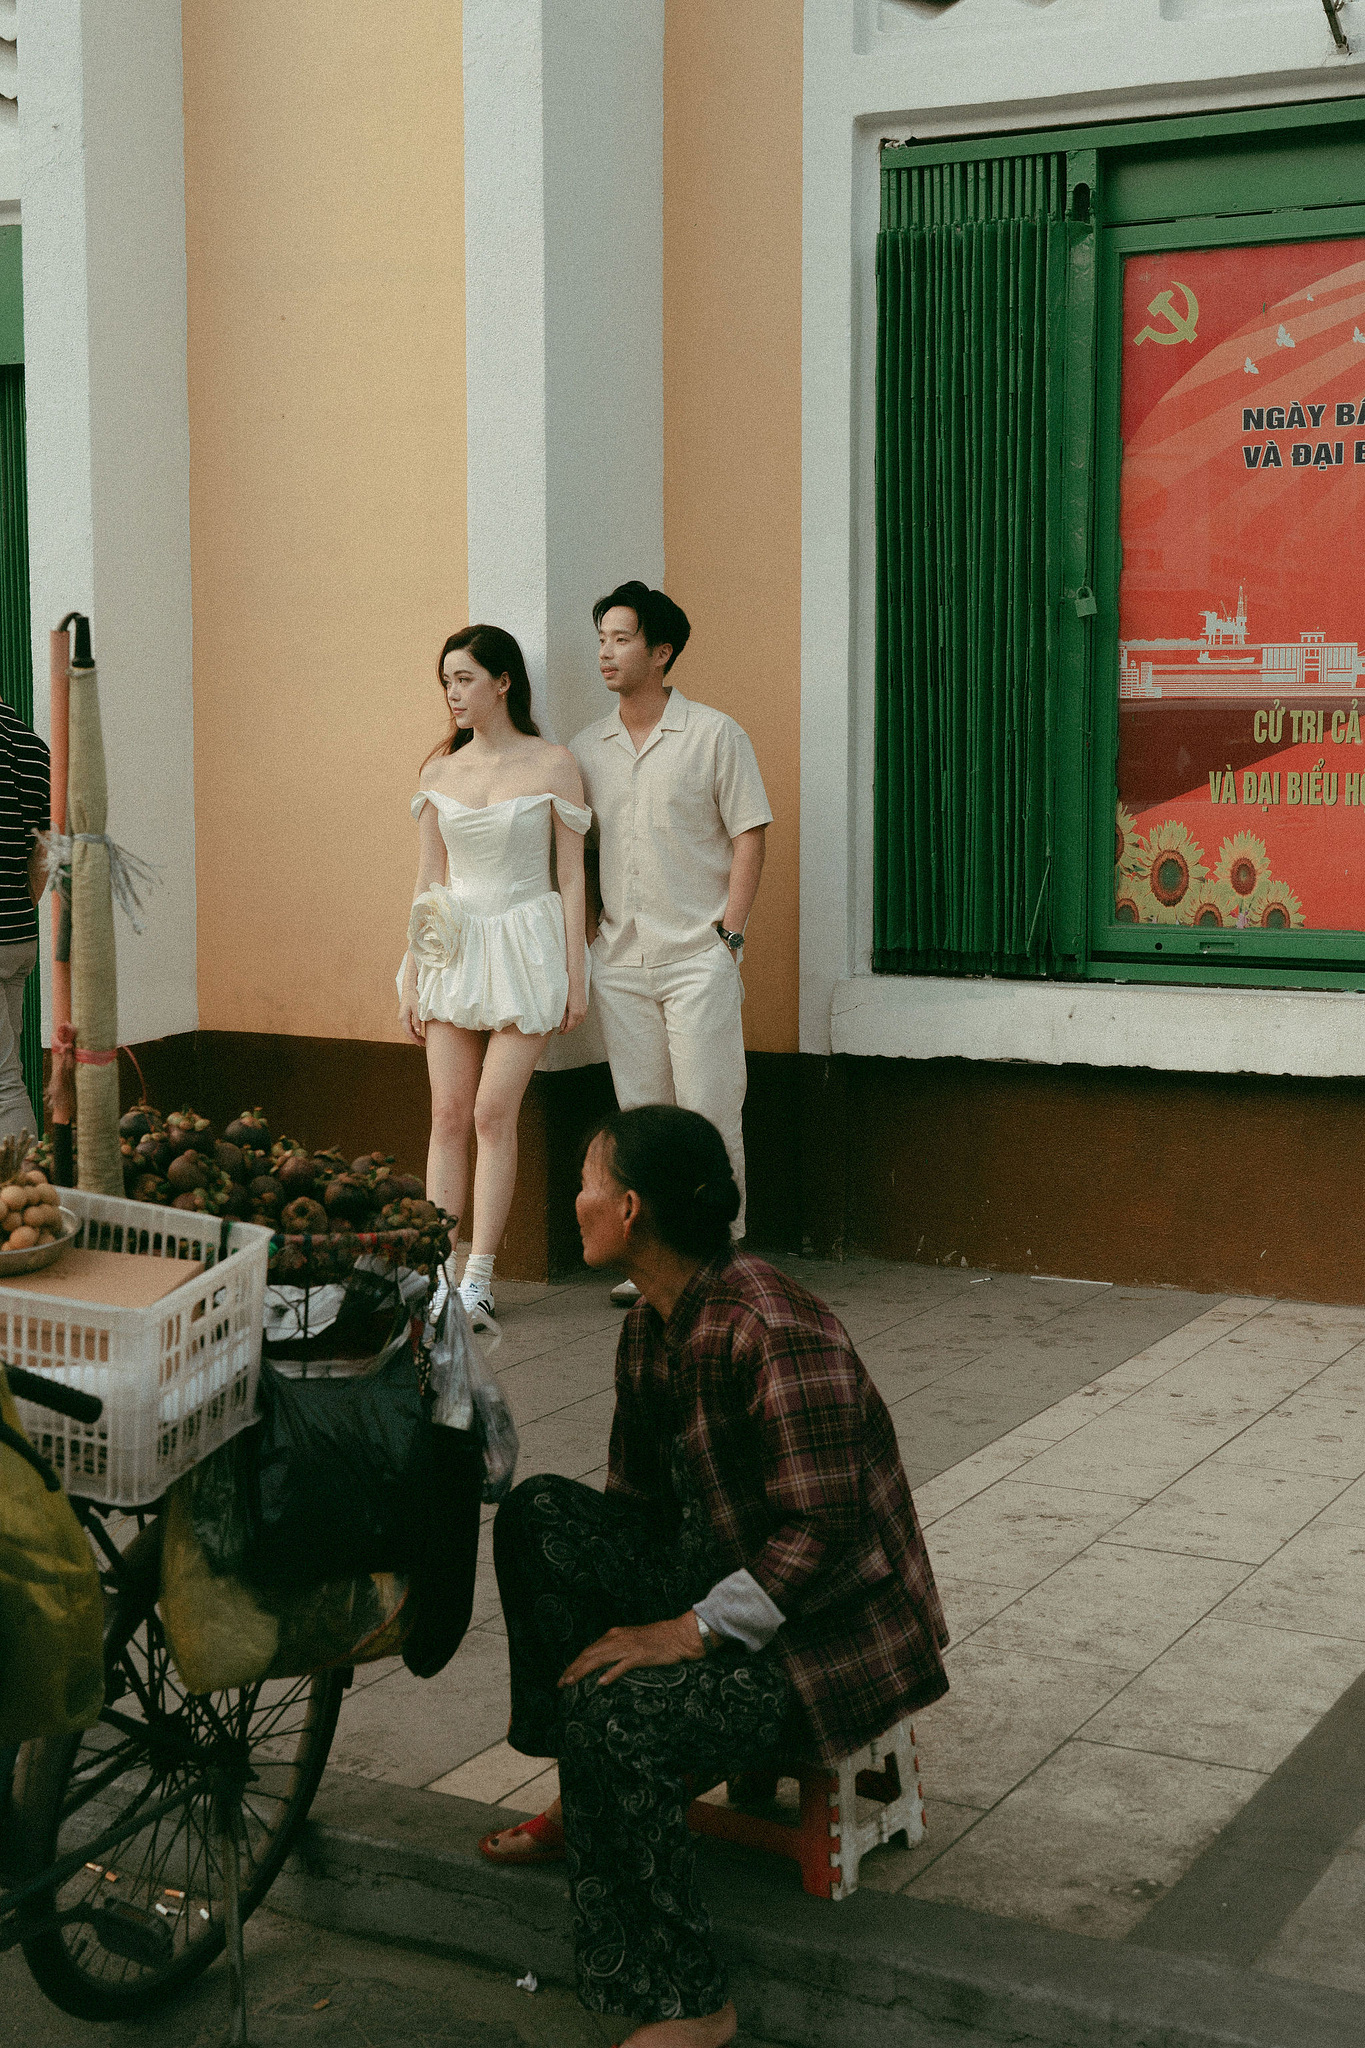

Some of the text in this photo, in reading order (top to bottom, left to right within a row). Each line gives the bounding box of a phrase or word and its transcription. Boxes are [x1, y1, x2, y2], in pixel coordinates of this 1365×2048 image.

[1242, 401, 1327, 431] NGÀY
[1242, 440, 1283, 469] VÀ
[1290, 441, 1344, 471] ĐẠI
[1253, 699, 1362, 744] CỬ TRI CẢ
[1208, 764, 1237, 804] VÀ
[1242, 771, 1280, 812] ĐẠI
[1286, 758, 1338, 806] BIỂU
